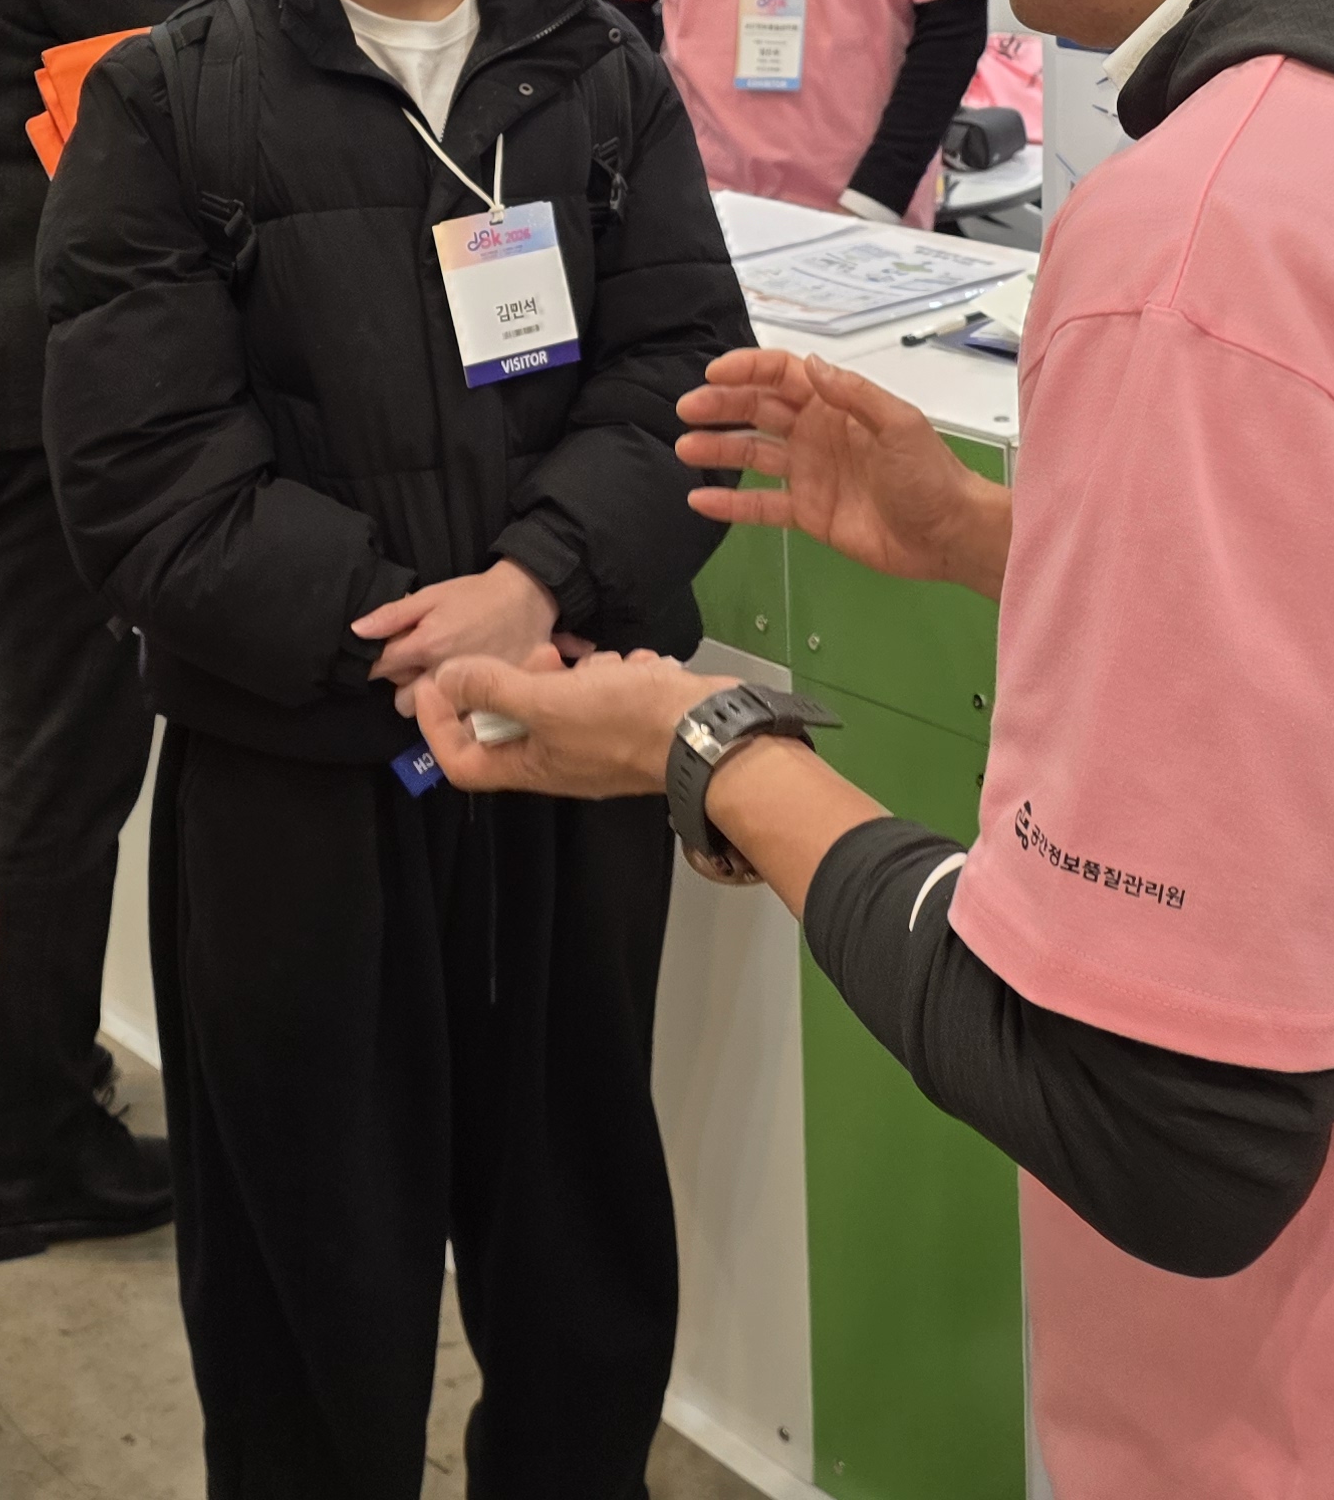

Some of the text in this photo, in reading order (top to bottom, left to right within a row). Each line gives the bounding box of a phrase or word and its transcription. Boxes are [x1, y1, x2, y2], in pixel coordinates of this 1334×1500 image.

[496, 297, 538, 323] 김민석
[501, 351, 548, 374] VISITOR
[1030, 824, 1186, 909] 공간정보품질관리원
